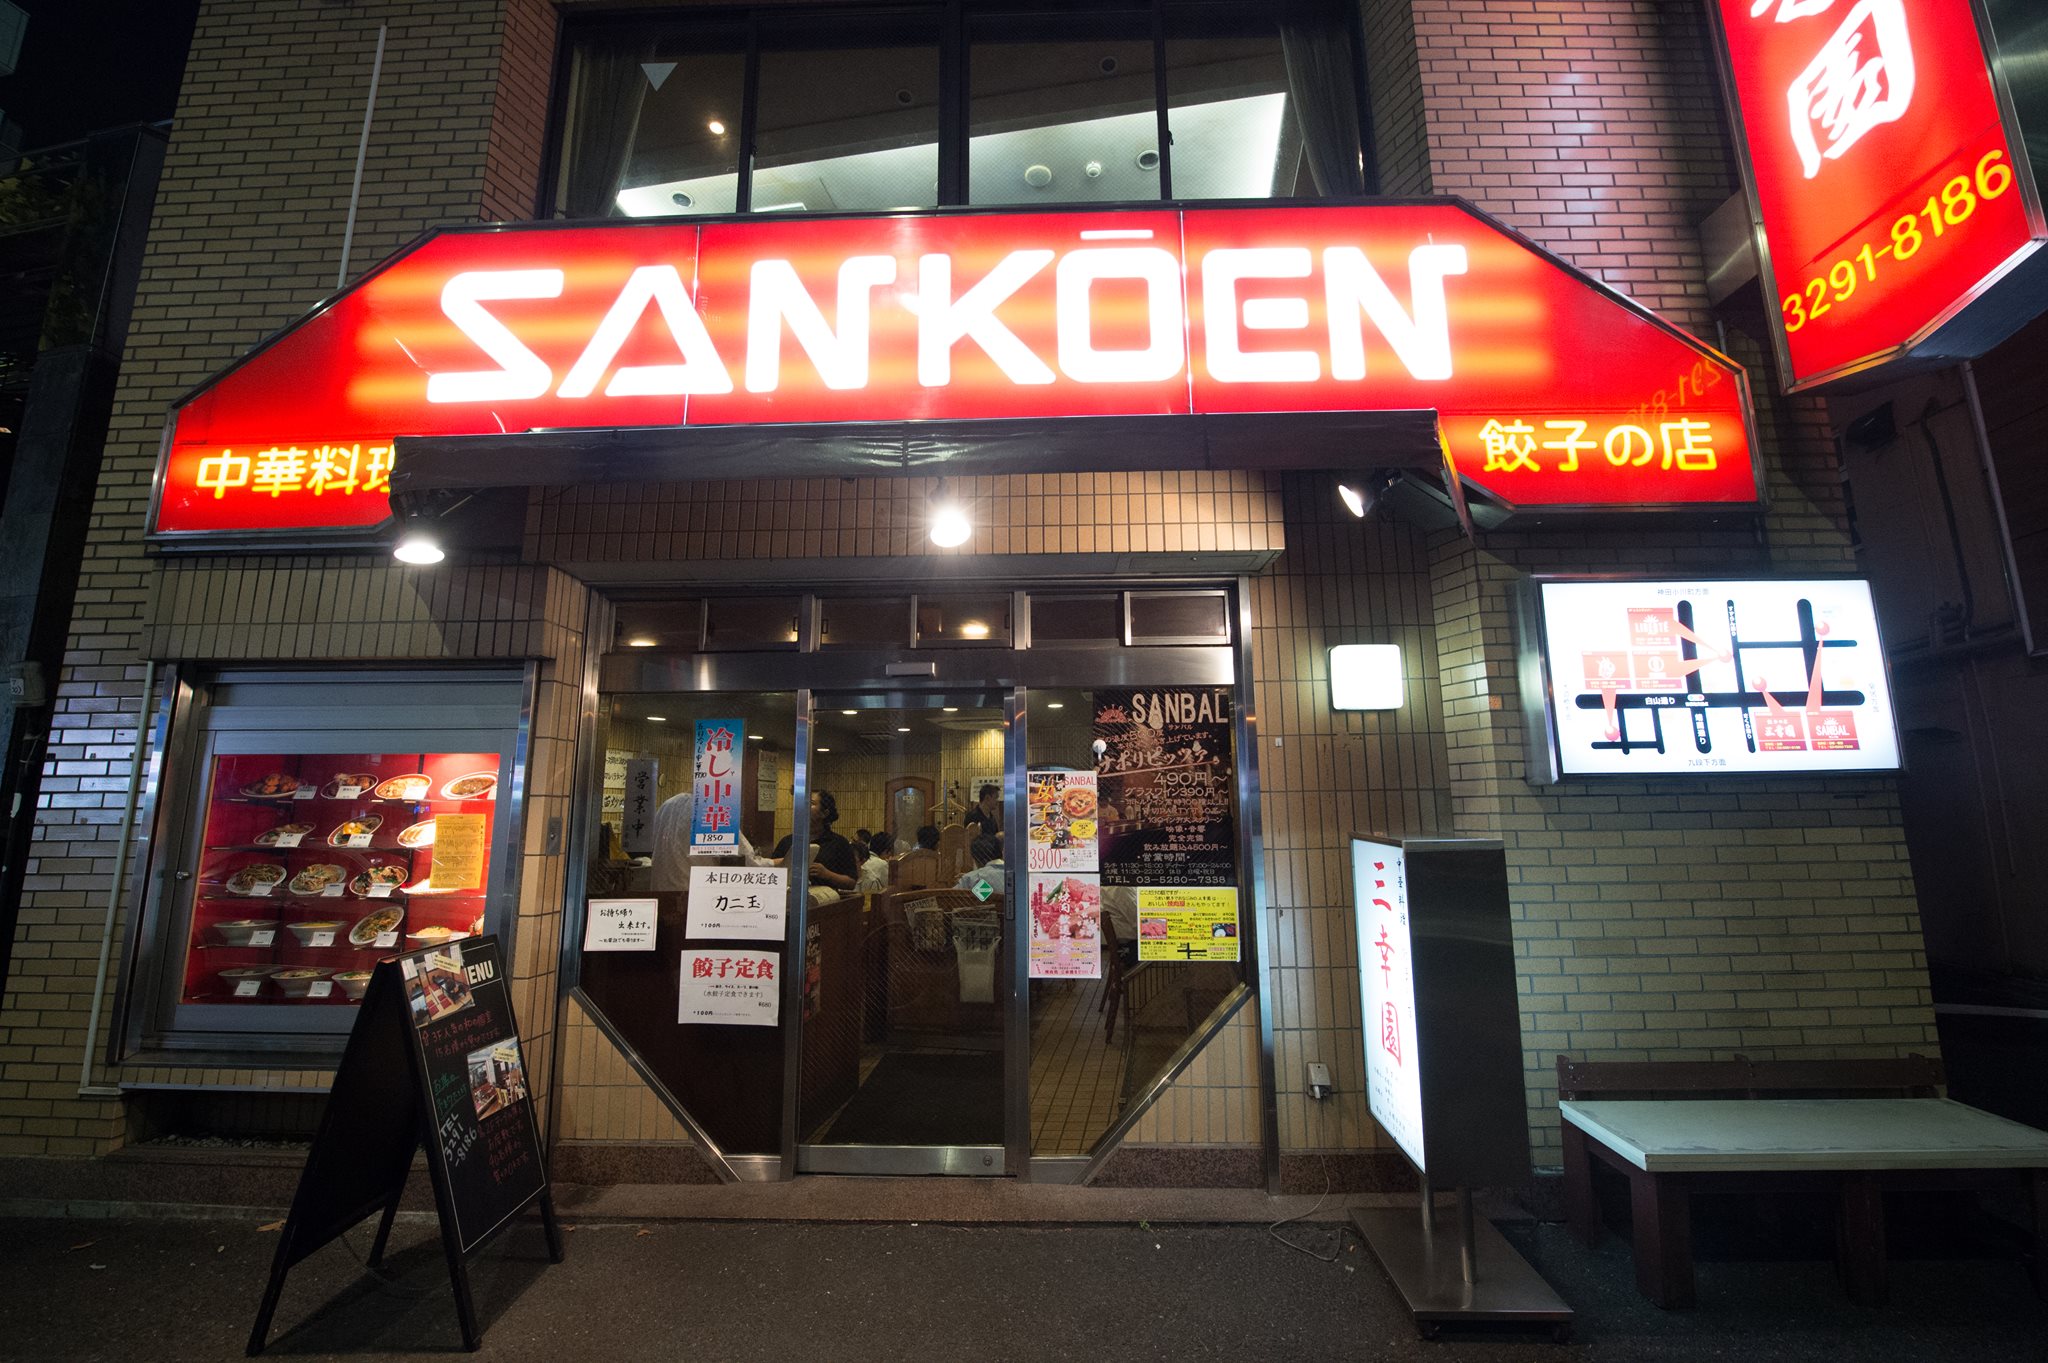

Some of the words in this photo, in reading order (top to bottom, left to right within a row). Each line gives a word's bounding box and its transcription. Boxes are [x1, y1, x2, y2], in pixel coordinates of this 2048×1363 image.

[1782, 149, 2012, 333] 3291-8186
[1478, 417, 1718, 472] 餃子の店
[1132, 693, 1229, 727] SANBAL
[1815, 725, 1850, 736] SANBAL
[704, 727, 735, 832] 冷し中華
[1064, 776, 1096, 786] SANBAL
[632, 771, 650, 838] 営業中
[705, 872, 778, 885] 本日の夜定食
[600, 908, 633, 917] お持ち帰り
[715, 895, 761, 911] カニ玉
[692, 957, 774, 980] 餃子定食
[440, 1113, 459, 1137] TEL
